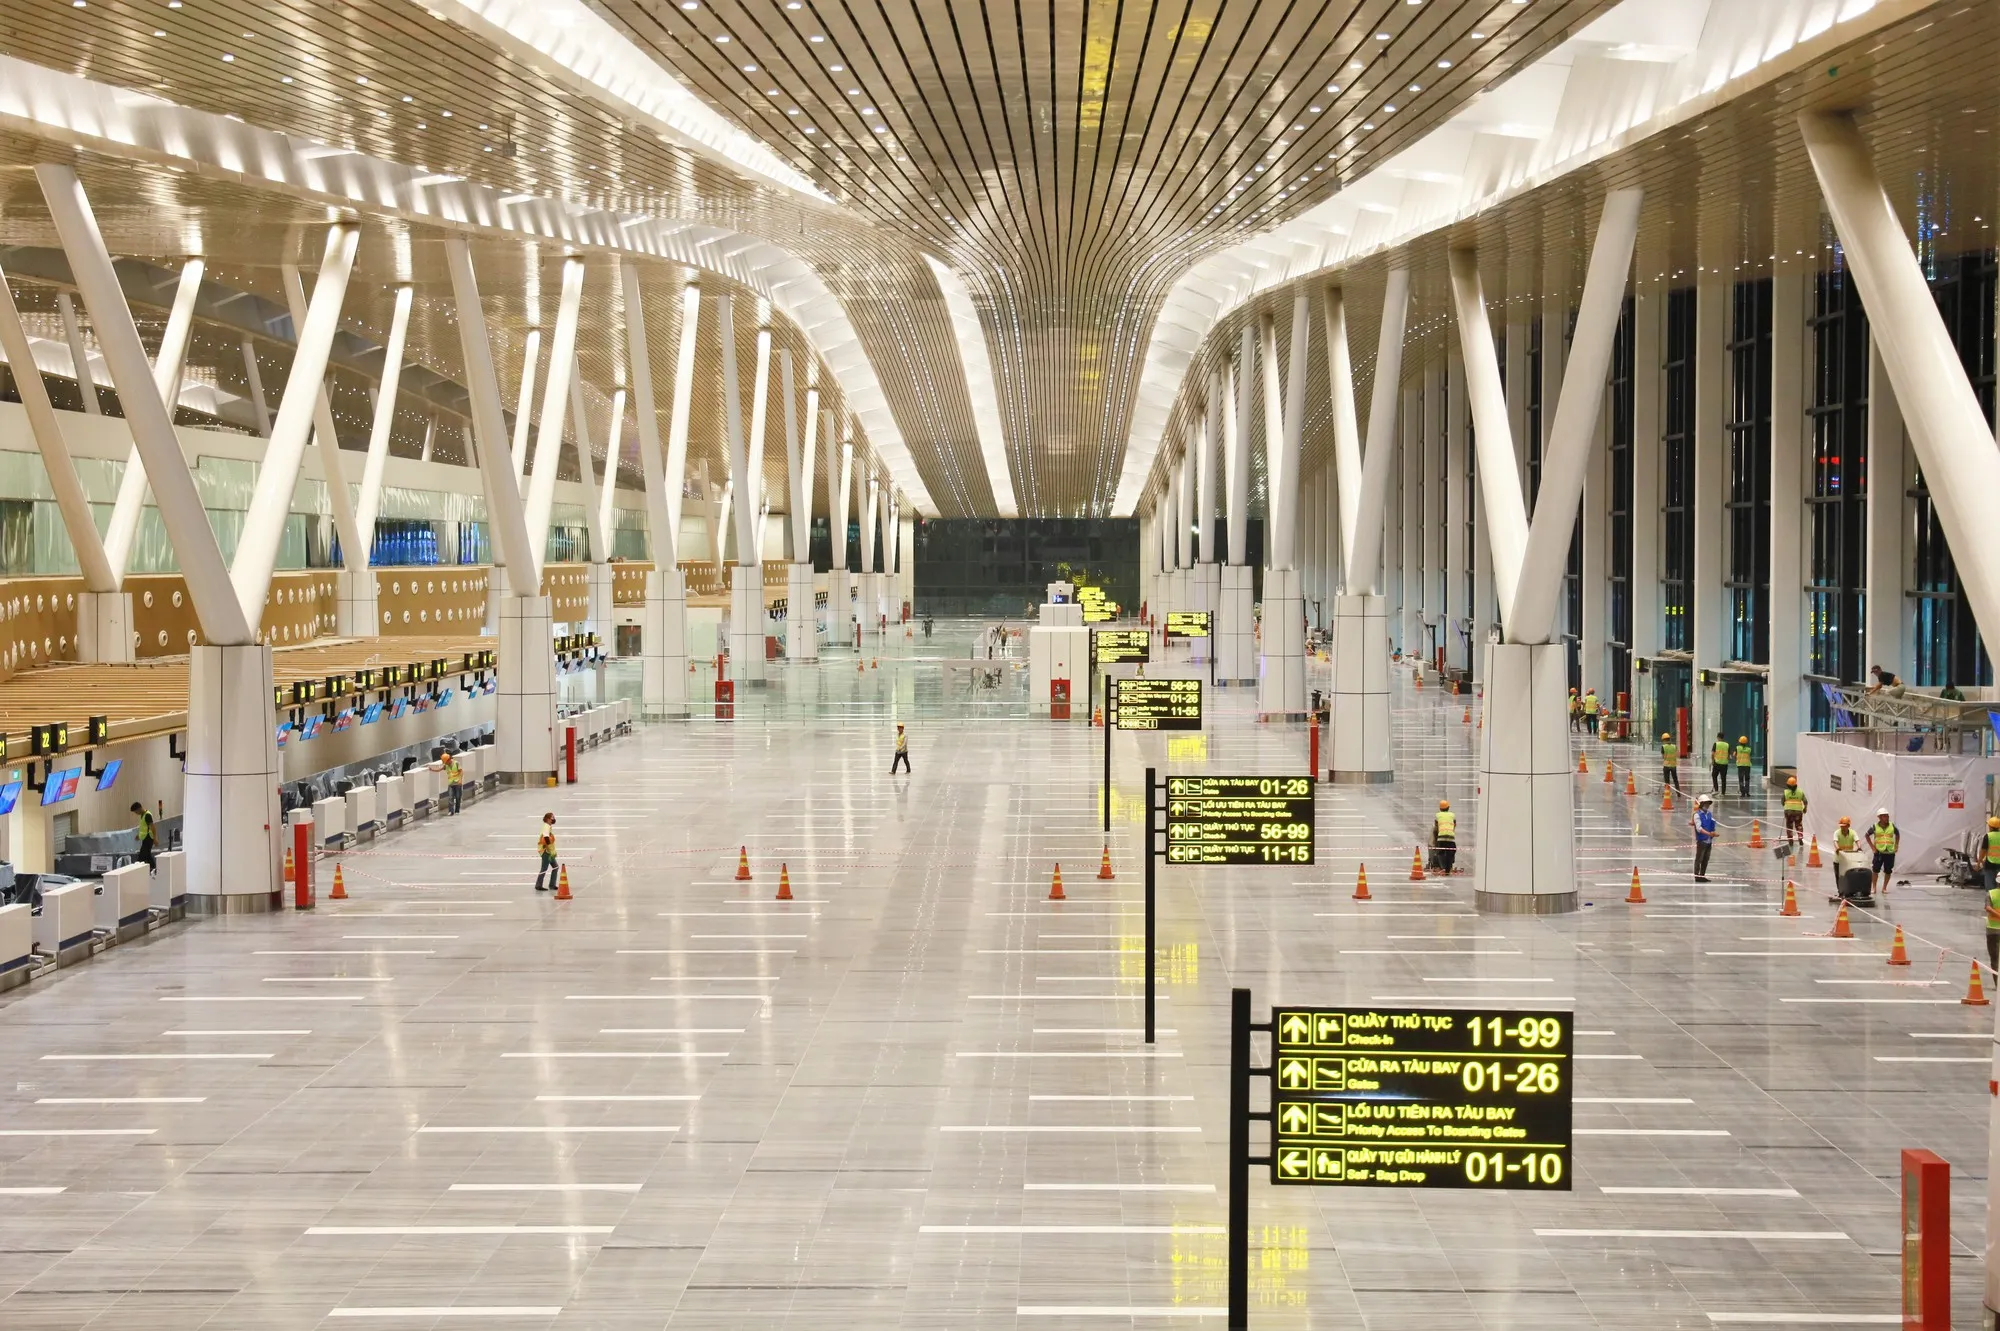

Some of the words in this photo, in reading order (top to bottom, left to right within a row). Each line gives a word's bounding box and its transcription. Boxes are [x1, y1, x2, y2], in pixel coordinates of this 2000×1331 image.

[42, 732, 50, 748] 22
[59, 729, 67, 745] 23
[1260, 779, 1308, 795] 01-26
[1261, 824, 1309, 839] 56-99
[1262, 846, 1309, 861] 11-15
[1347, 1012, 1388, 1029] QUẦY
[1390, 1013, 1420, 1029] THỦ
[1422, 1016, 1452, 1032] TỤC
[1467, 1017, 1560, 1048] 11-99
[1347, 1057, 1379, 1073] CỬA
[1380, 1060, 1401, 1073] RA
[1402, 1059, 1431, 1074] TÀU
[1432, 1061, 1461, 1074] BAY
[1347, 1079, 1379, 1090] Gates
[1463, 1061, 1559, 1093] 01-26
[1347, 1102, 1371, 1118] LỐI
[1373, 1105, 1395, 1119] ƯU
[1397, 1104, 1430, 1119] TIÊN
[1432, 1106, 1453, 1119] RA
[1455, 1105, 1484, 1120] TÀU
[1486, 1107, 1515, 1120] BAY
[1347, 1124, 1386, 1138] Priority
[1386, 1125, 1426, 1136] Access
[1427, 1125, 1443, 1136] To
[1443, 1125, 1492, 1140] Boarding
[1493, 1126, 1526, 1138] Gates
[1347, 1147, 1377, 1163] QUẦY
[1447, 1150, 1462, 1164] LÝ
[1347, 1169, 1370, 1180] Self
[1399, 1170, 1425, 1182] Drop
[1466, 1152, 1561, 1183] 01-10
